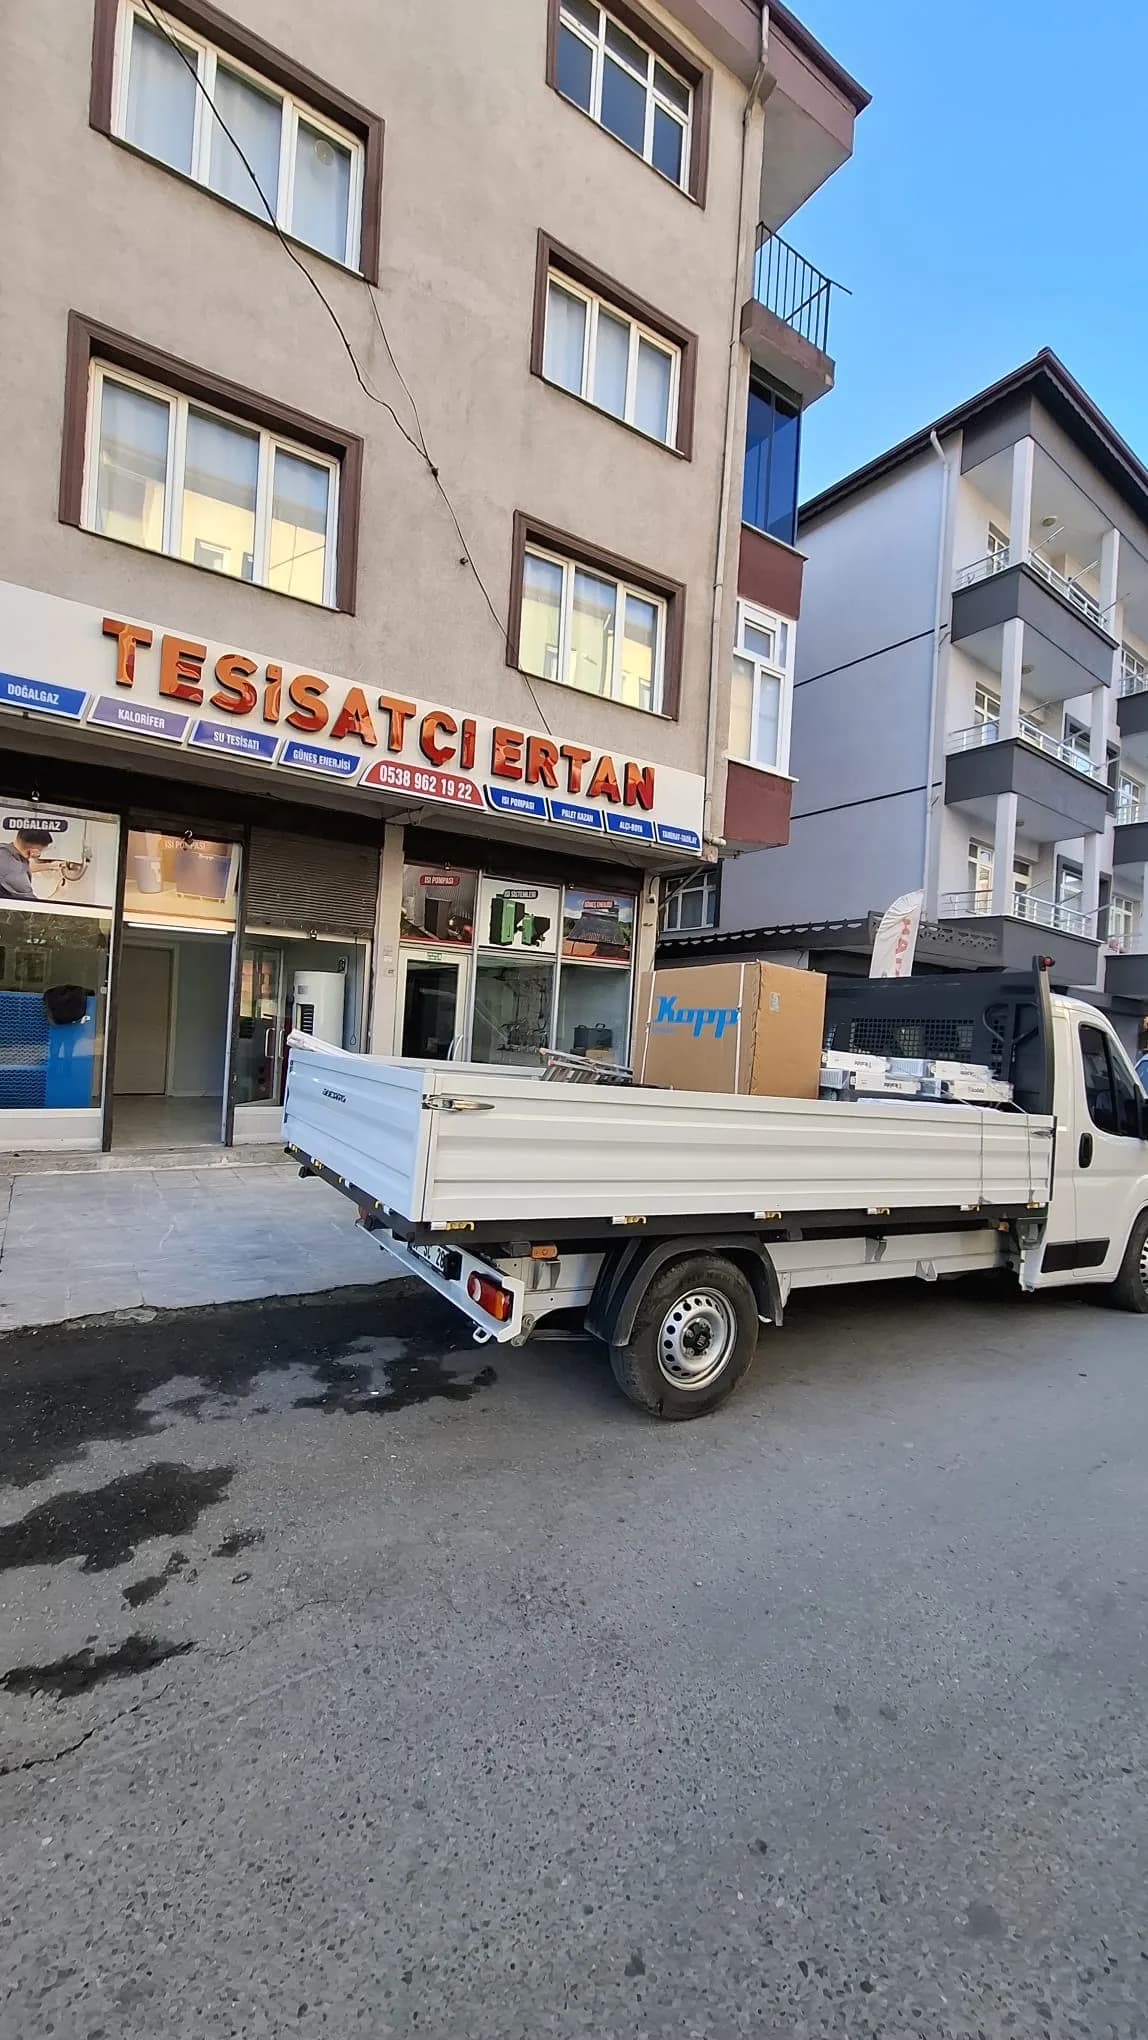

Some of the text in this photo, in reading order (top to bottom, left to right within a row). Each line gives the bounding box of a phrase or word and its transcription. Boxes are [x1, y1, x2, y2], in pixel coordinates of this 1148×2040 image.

[7, 683, 60, 705] DOĞALGAZ
[102, 616, 655, 810] TESİSATÇI ERTAN
[117, 708, 165, 729] KALORİFER
[213, 731, 260, 751] SU TESİSATI
[380, 765, 473, 801] 0538 962 19 22
[9, 818, 61, 831] DOĞALGAZ
[175, 840, 207, 850] POPASI
